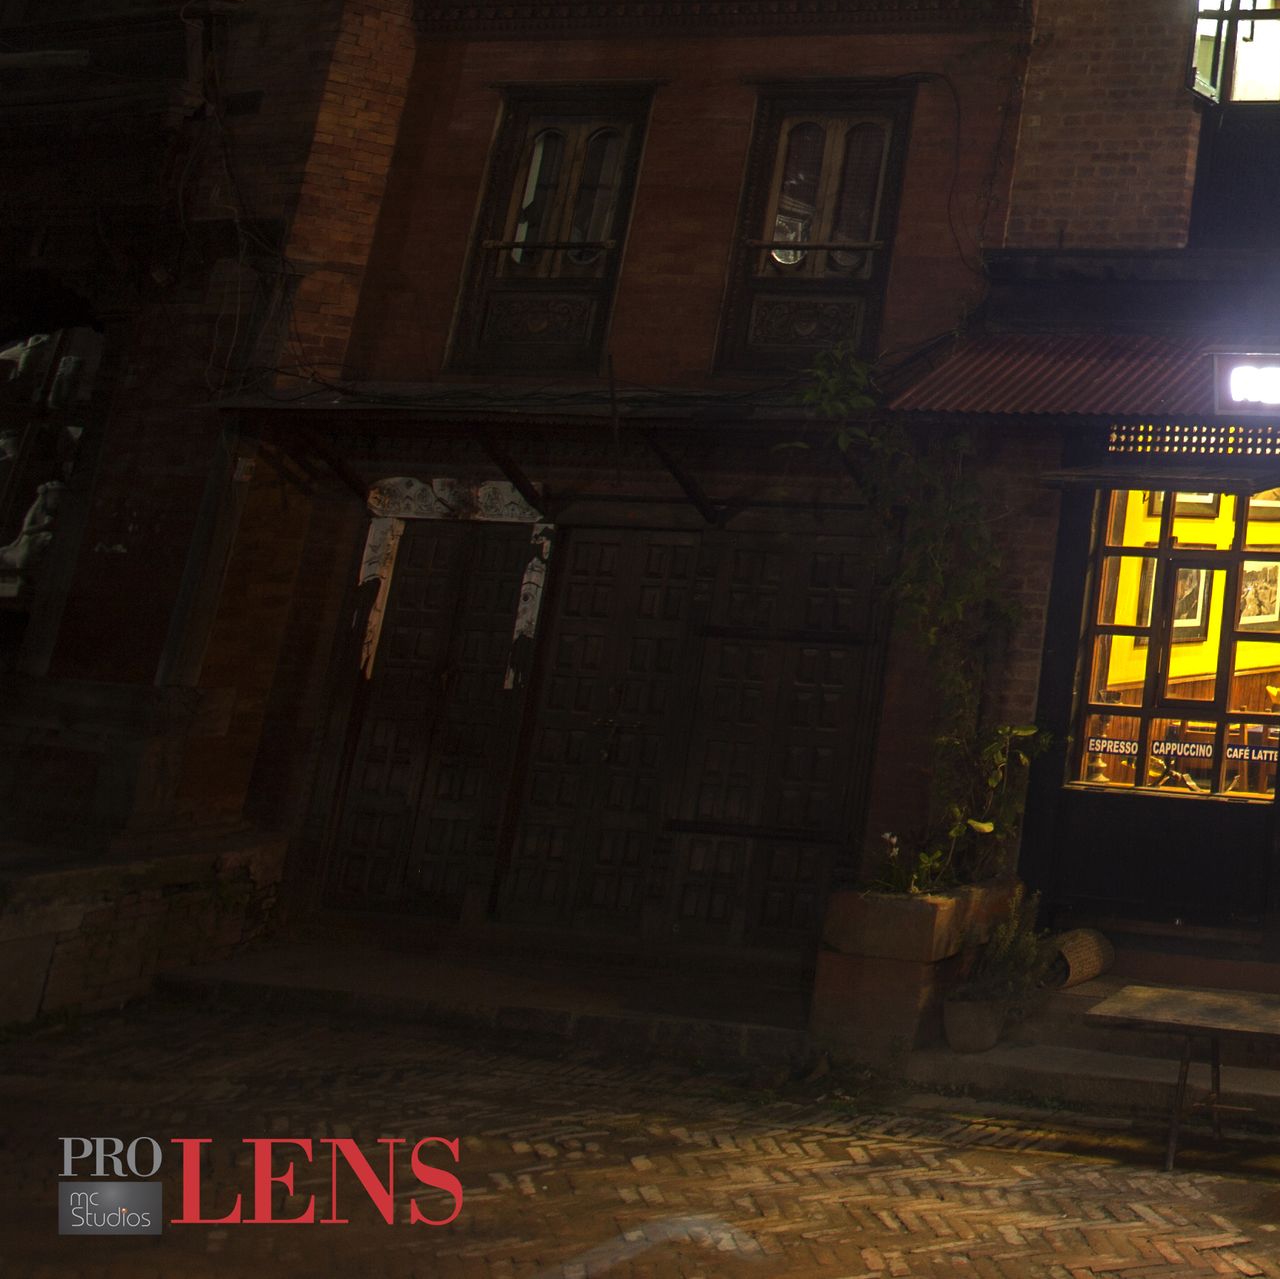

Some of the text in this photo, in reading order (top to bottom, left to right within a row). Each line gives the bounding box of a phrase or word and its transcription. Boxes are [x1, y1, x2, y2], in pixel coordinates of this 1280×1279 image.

[1088, 738, 1138, 754] ESPRESSO
[1152, 742, 1213, 758] CAPPUCCINO
[1226, 747, 1279, 761] CAFÉ LATTE
